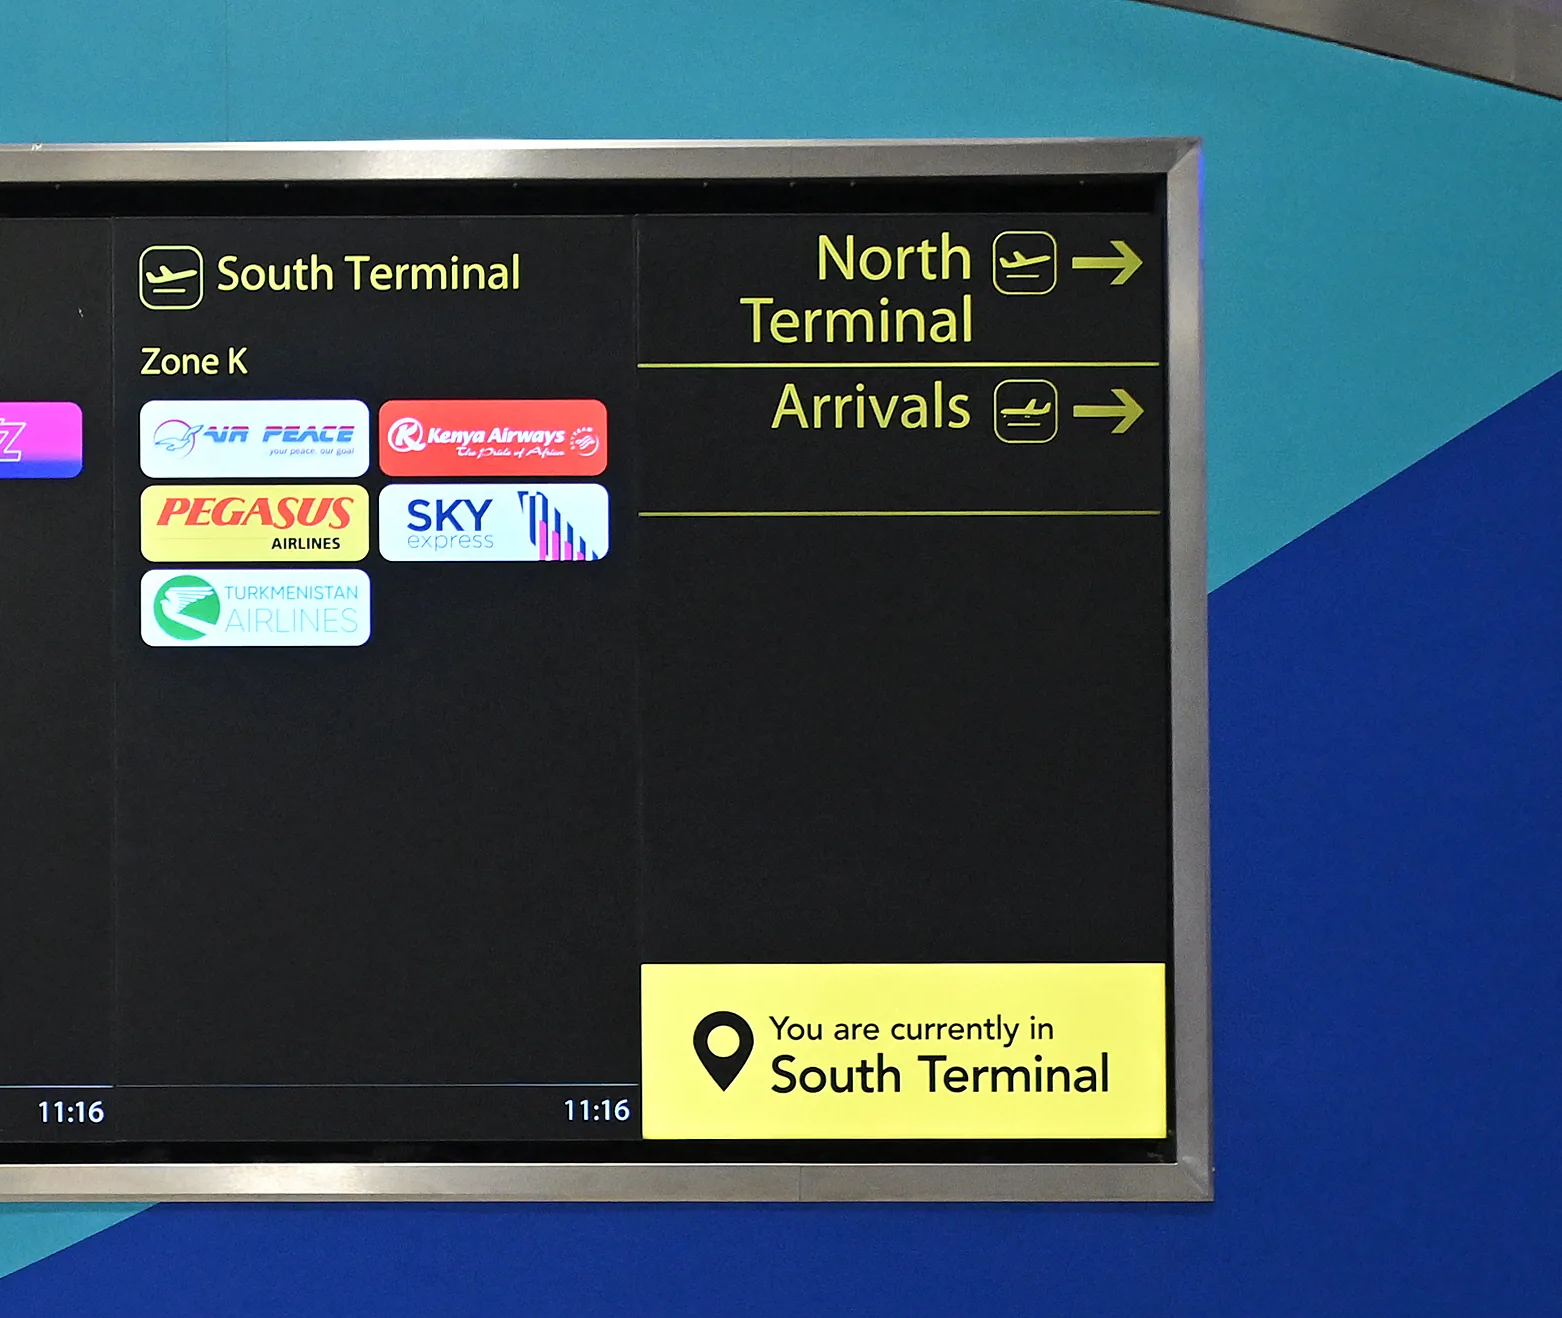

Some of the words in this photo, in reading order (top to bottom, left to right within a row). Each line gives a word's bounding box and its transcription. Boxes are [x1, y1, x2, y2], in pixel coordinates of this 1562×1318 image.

[819, 232, 970, 280] North
[218, 254, 333, 290] South
[345, 254, 518, 290] Terminal
[740, 295, 971, 343] Terminal
[141, 348, 219, 374] Zone
[229, 348, 247, 374] K
[772, 381, 970, 428] Arrivals
[201, 425, 249, 442] AIR
[263, 426, 354, 442] PEACE
[425, 428, 488, 446] Kenya
[485, 428, 565, 448] Airways
[269, 448, 288, 456] your
[336, 447, 355, 456] goal
[157, 497, 354, 529] PEGASUS
[407, 499, 493, 531] SKY
[272, 538, 340, 549] AIRLINES
[408, 535, 493, 551] express
[225, 586, 357, 600] TURKMENISTAN
[225, 608, 357, 633] AIRLINES
[769, 1016, 822, 1040] You
[834, 1023, 879, 1040] are
[891, 1014, 1019, 1047] currently
[1031, 1016, 1053, 1039] in
[772, 1053, 900, 1093] South
[918, 1052, 1108, 1092] Terminal
[39, 1101, 104, 1122] 11:16
[565, 1099, 629, 1120] 11:16
